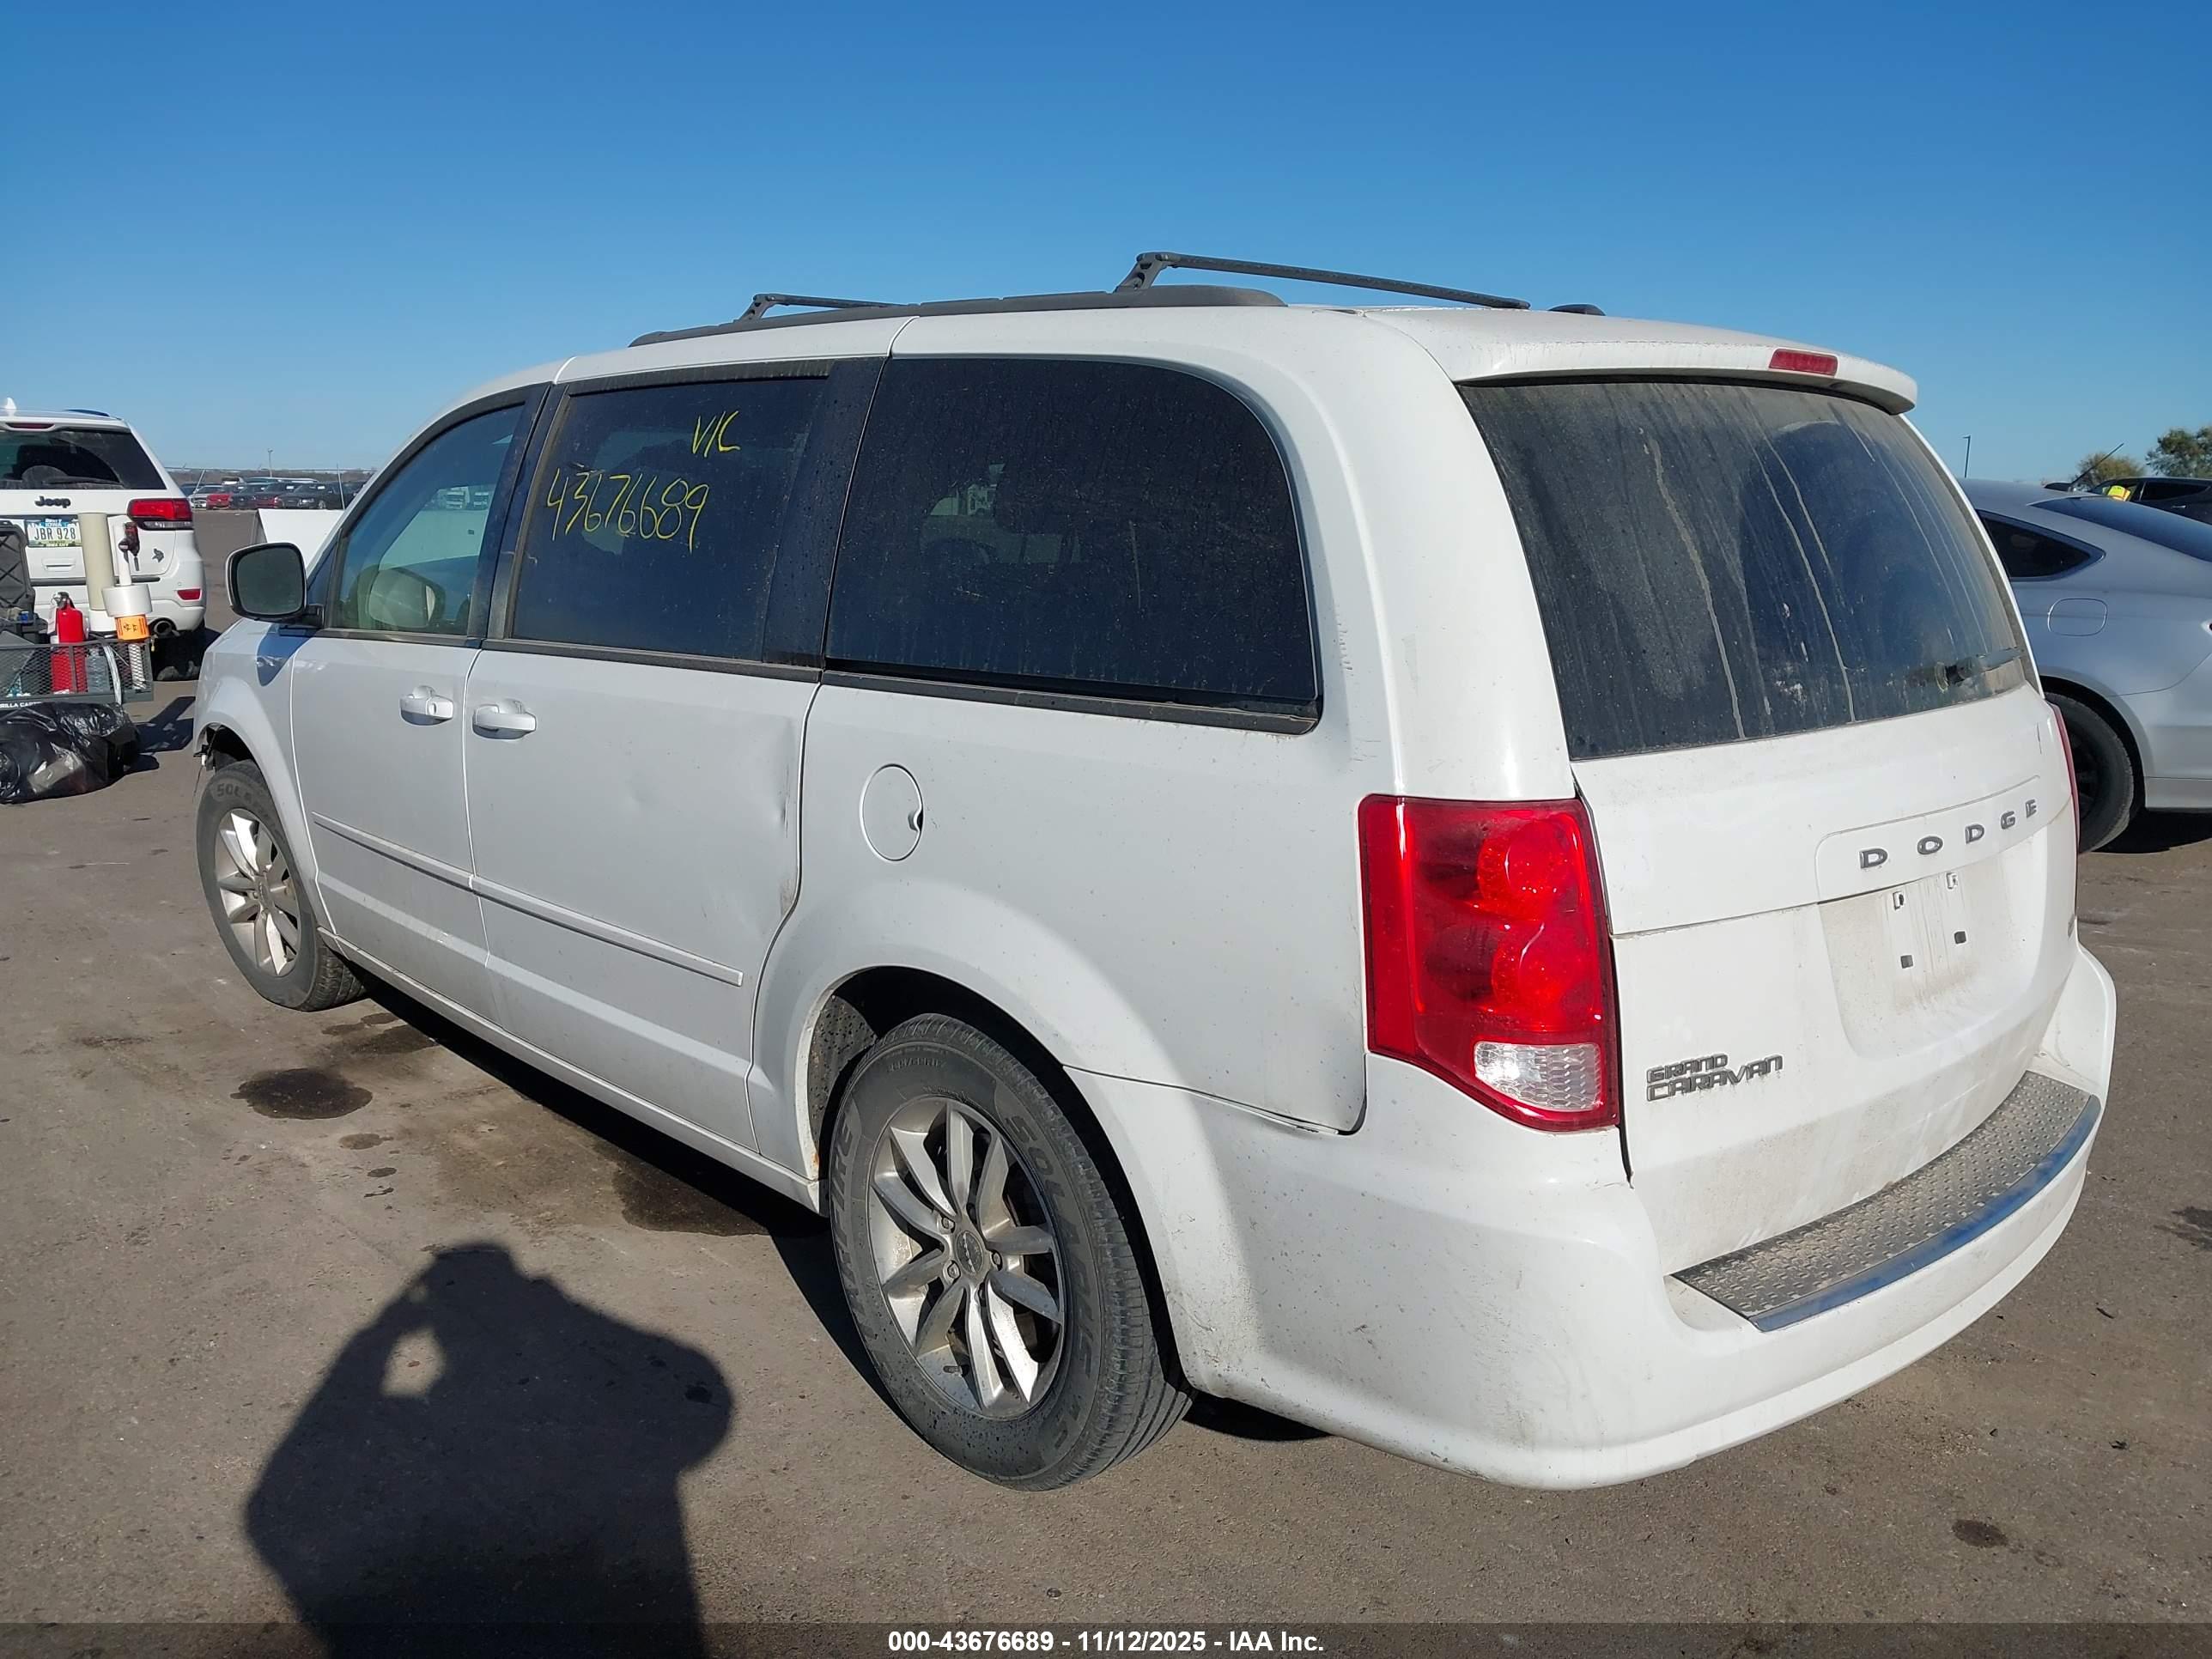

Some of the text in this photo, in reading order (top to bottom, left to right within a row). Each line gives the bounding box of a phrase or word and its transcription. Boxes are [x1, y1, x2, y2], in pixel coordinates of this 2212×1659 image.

[34, 495, 71, 508] Jeep
[547, 468, 709, 554] 43676689
[34, 527, 76, 540] JBR 928
[1858, 799, 2038, 869] DODGE
[1647, 1054, 1729, 1084] GRAND
[1647, 1054, 1783, 1102] CARAVAN
